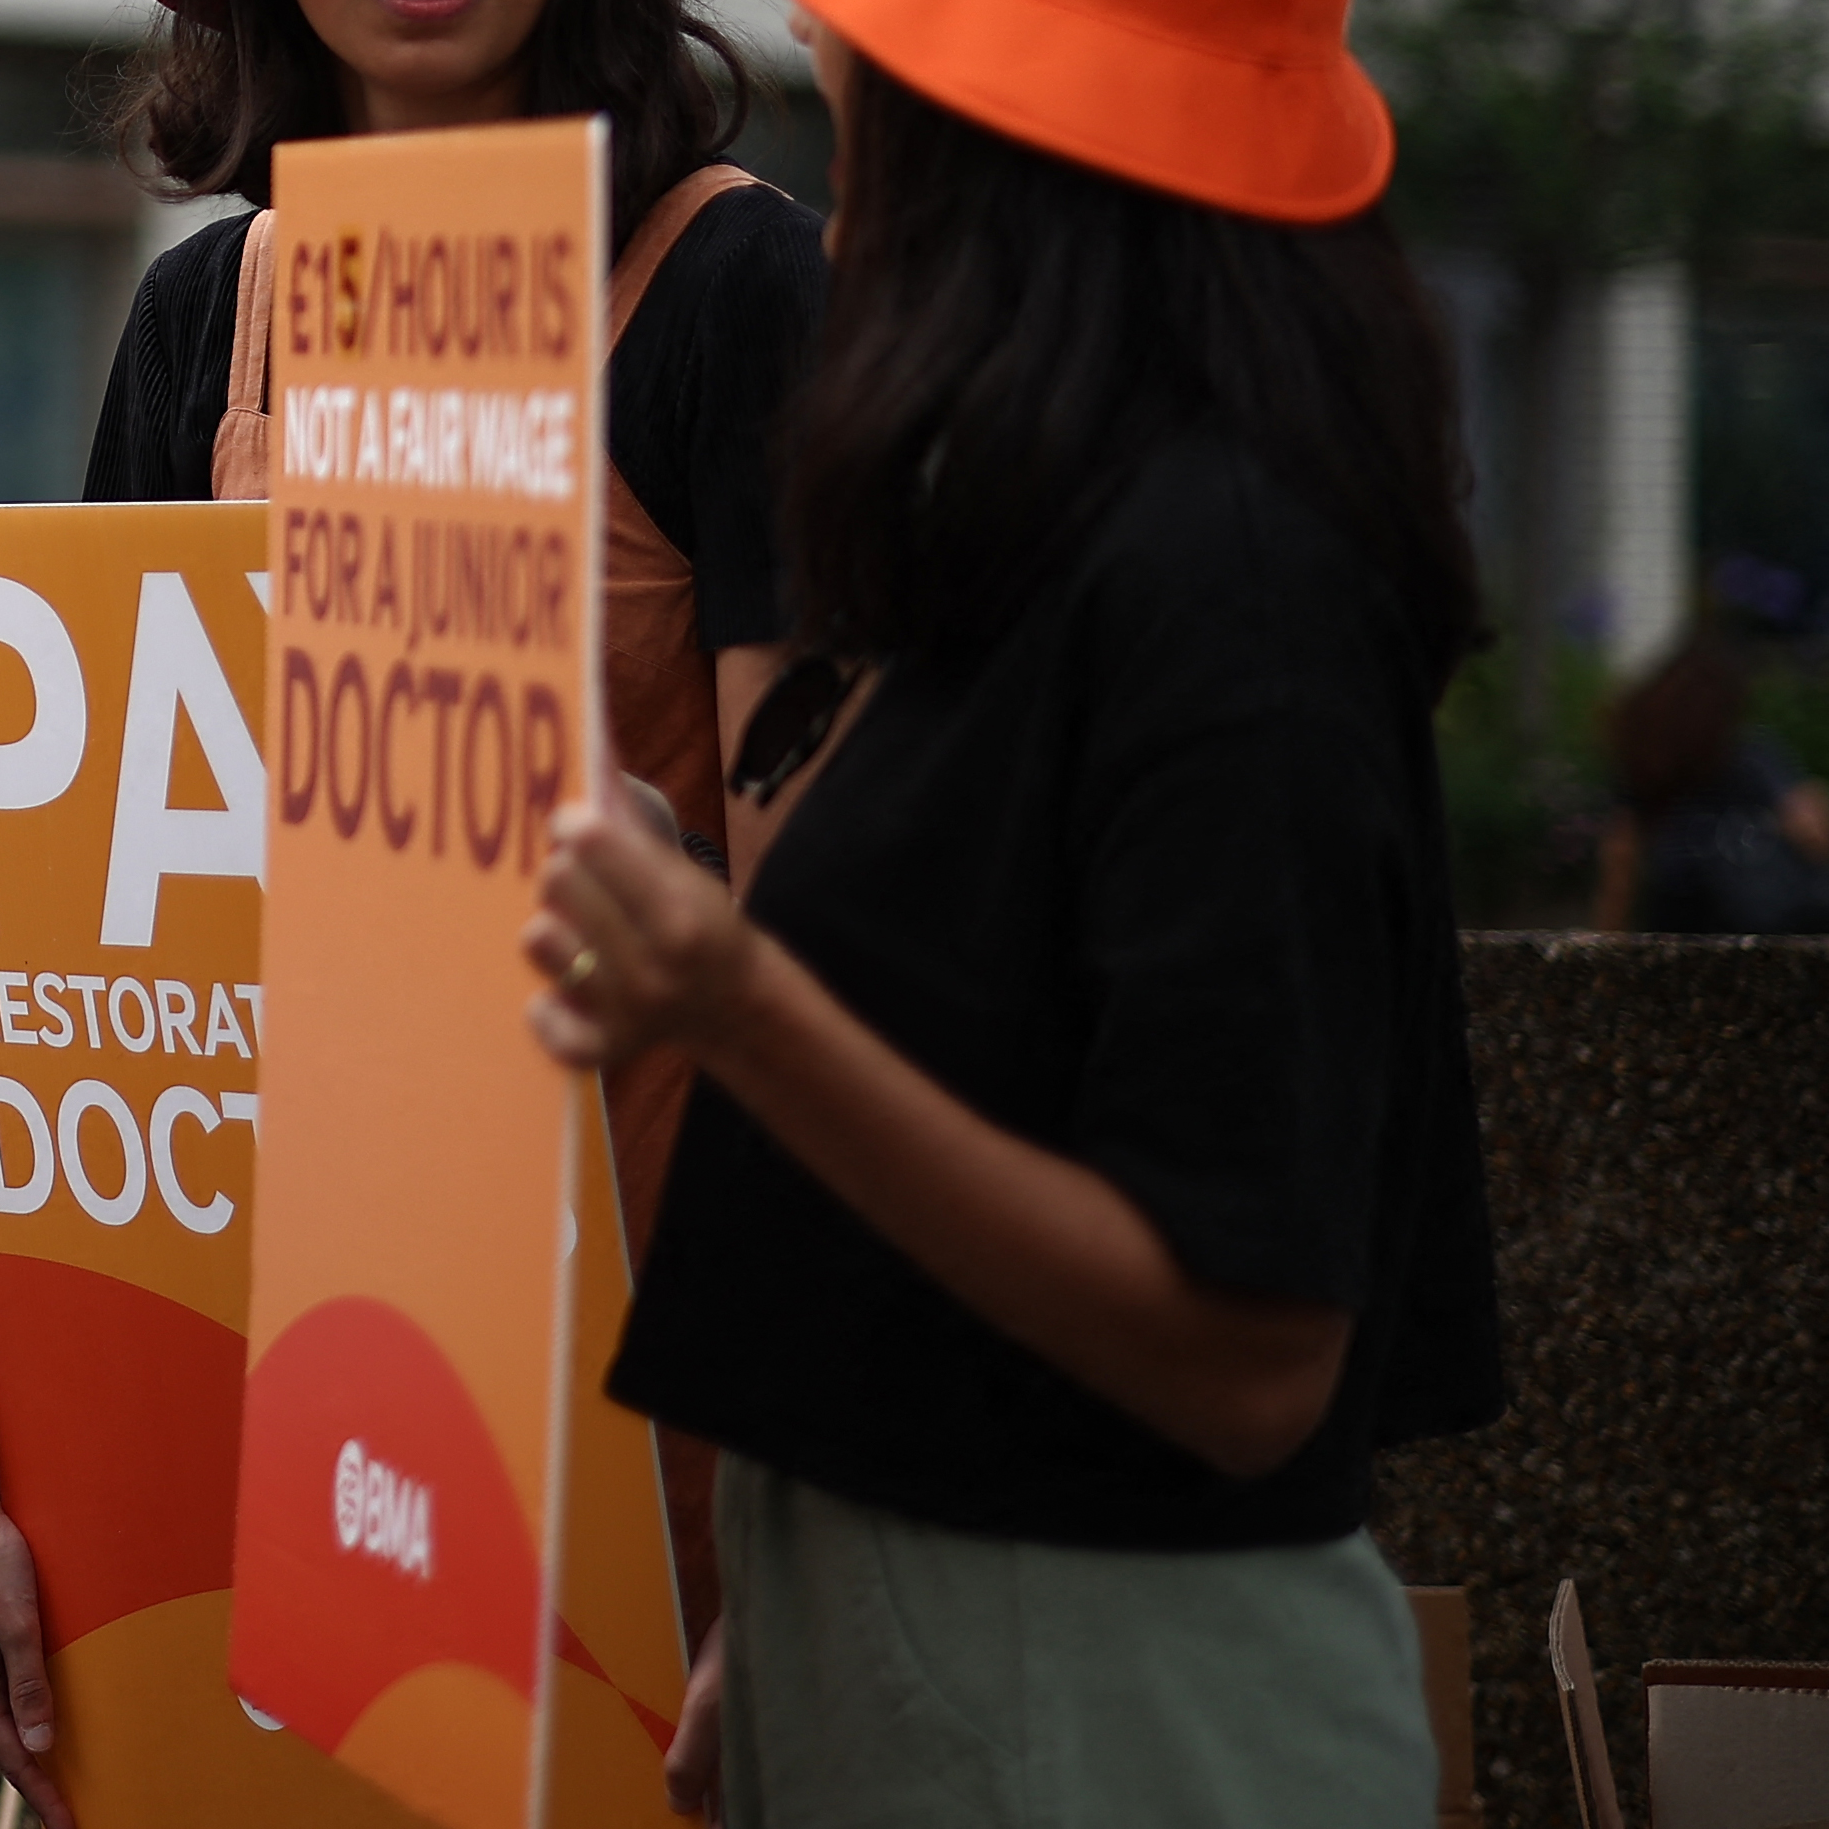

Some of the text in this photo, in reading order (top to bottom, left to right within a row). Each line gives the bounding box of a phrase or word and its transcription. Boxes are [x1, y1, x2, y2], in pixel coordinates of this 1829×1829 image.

[288, 227, 575, 360] £15/HOUR IS
[285, 387, 573, 498] NOT A FAIR WAGE
[284, 508, 571, 655] FOR A JUNIOR
[281, 648, 567, 876] DOCTOR
[365, 1457, 432, 1578] BMA
